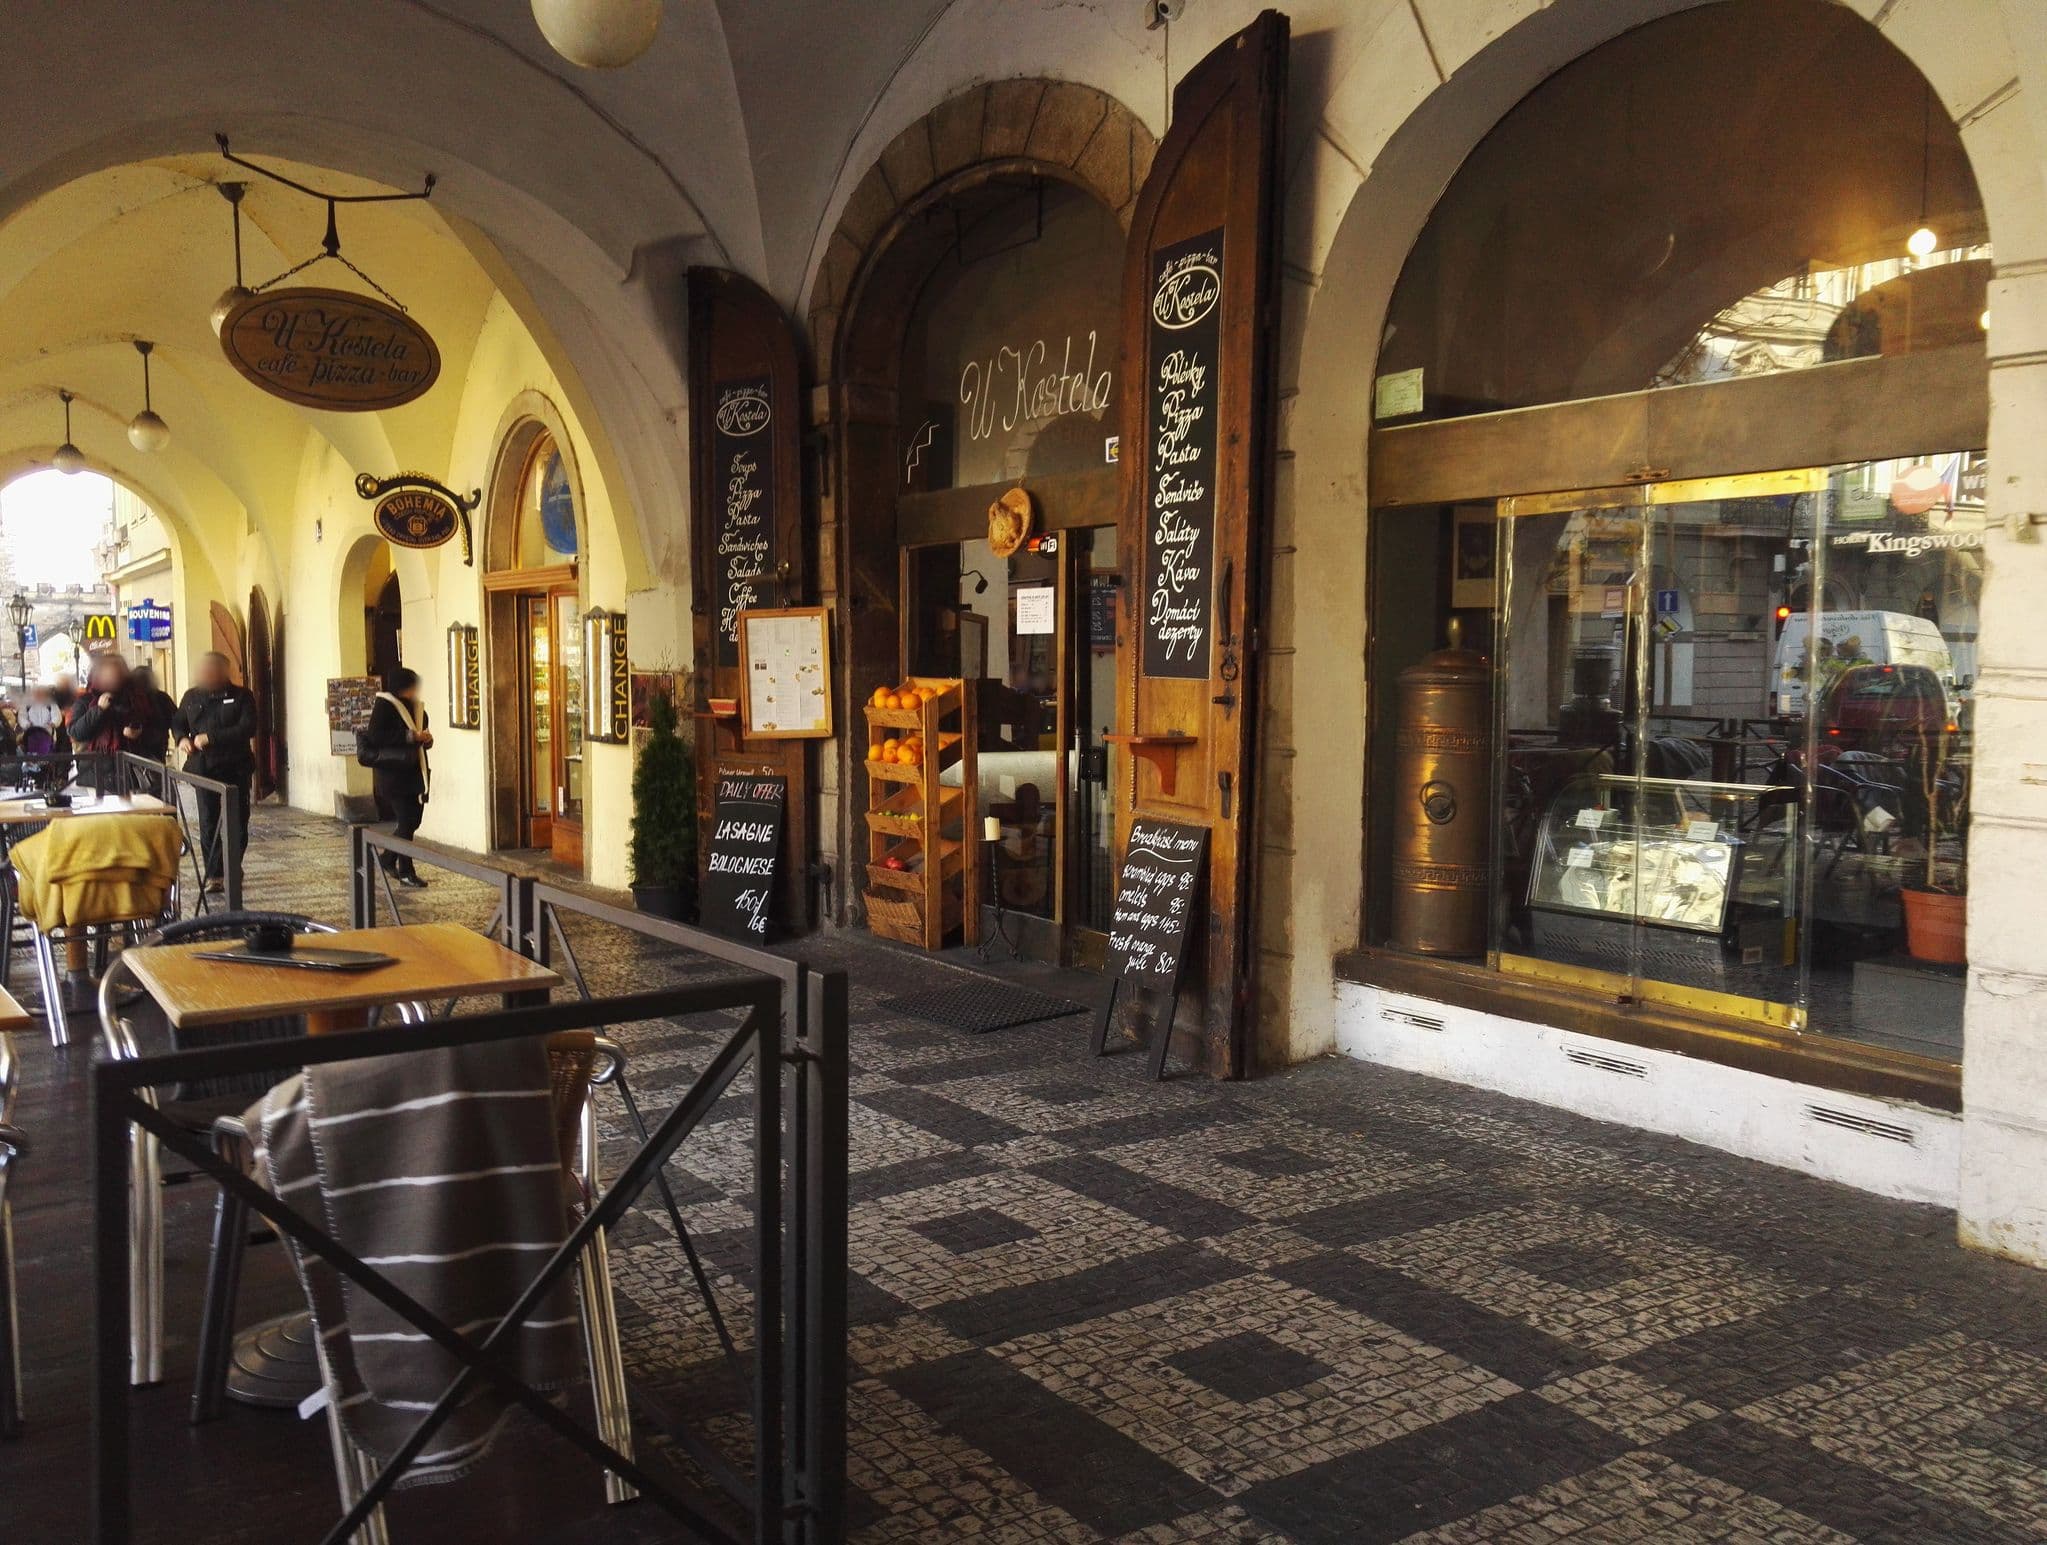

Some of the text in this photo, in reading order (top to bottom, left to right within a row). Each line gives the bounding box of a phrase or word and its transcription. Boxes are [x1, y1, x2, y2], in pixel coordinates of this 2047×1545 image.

[262, 309, 300, 351] U
[309, 355, 377, 388] pizza
[387, 361, 425, 384] bar
[960, 329, 1112, 441] U Kostela
[1158, 349, 1206, 399] Polévky
[1158, 389, 1204, 442] Pizza
[730, 450, 757, 481] Soups
[1155, 431, 1202, 472] Pasta
[386, 495, 446, 519] BOHEMIA
[726, 476, 763, 511] Pizza
[724, 501, 761, 530] Pasta
[718, 529, 769, 562] Sandwiches
[1154, 509, 1201, 559] Saláty
[1866, 531, 1983, 558] Kingswoo
[727, 555, 764, 580] Salads
[1157, 549, 1201, 593] Káva
[728, 579, 758, 611] Coffee
[1150, 588, 1201, 626] Domácí
[1157, 618, 1204, 662] dezerty
[467, 630, 480, 726] CHANGE
[614, 617, 628, 741] CHANGE
[719, 780, 785, 800] DAILY OFFER
[714, 819, 774, 844] LASAGNE
[1130, 825, 1200, 852] Breakfast menu
[708, 852, 776, 876] BOLOGNESE
